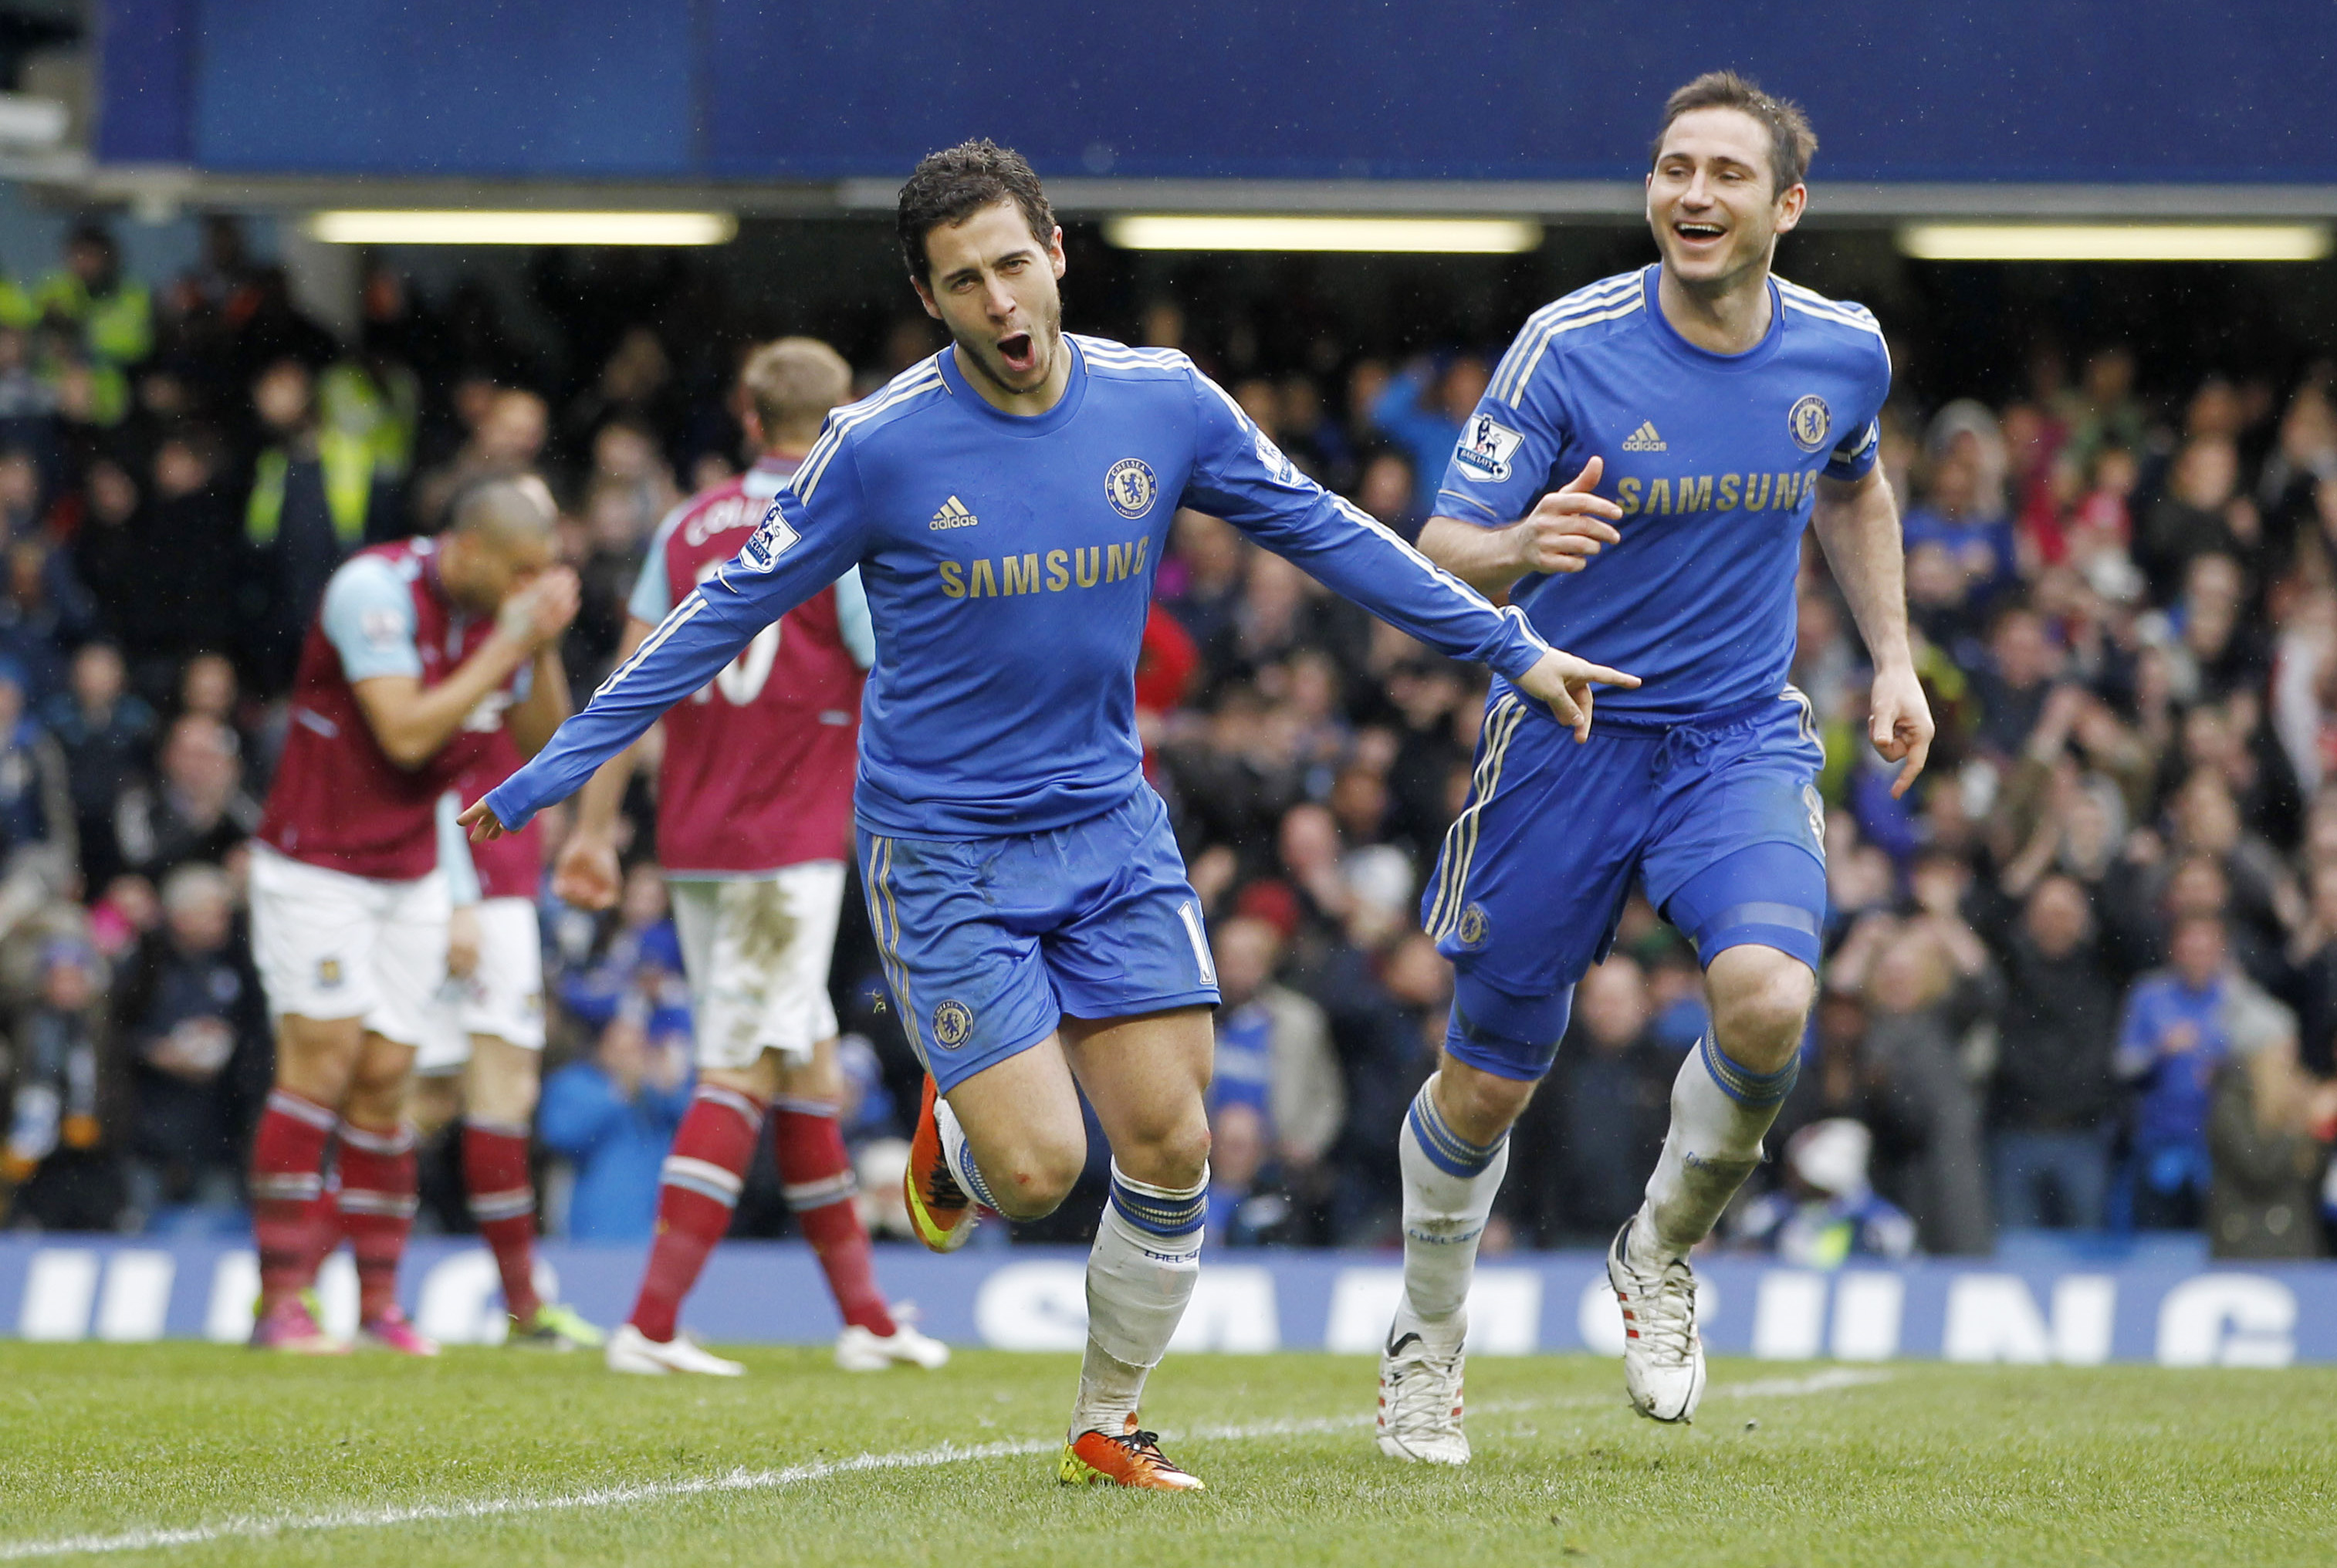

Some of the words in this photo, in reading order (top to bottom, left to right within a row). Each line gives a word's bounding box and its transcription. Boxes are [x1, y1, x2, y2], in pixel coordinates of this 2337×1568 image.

[1622, 441, 1667, 452] adidas
[1111, 461, 1145, 476] CHELSEA
[928, 515, 979, 531] adidas
[939, 536, 1149, 599] SAMSUNG
